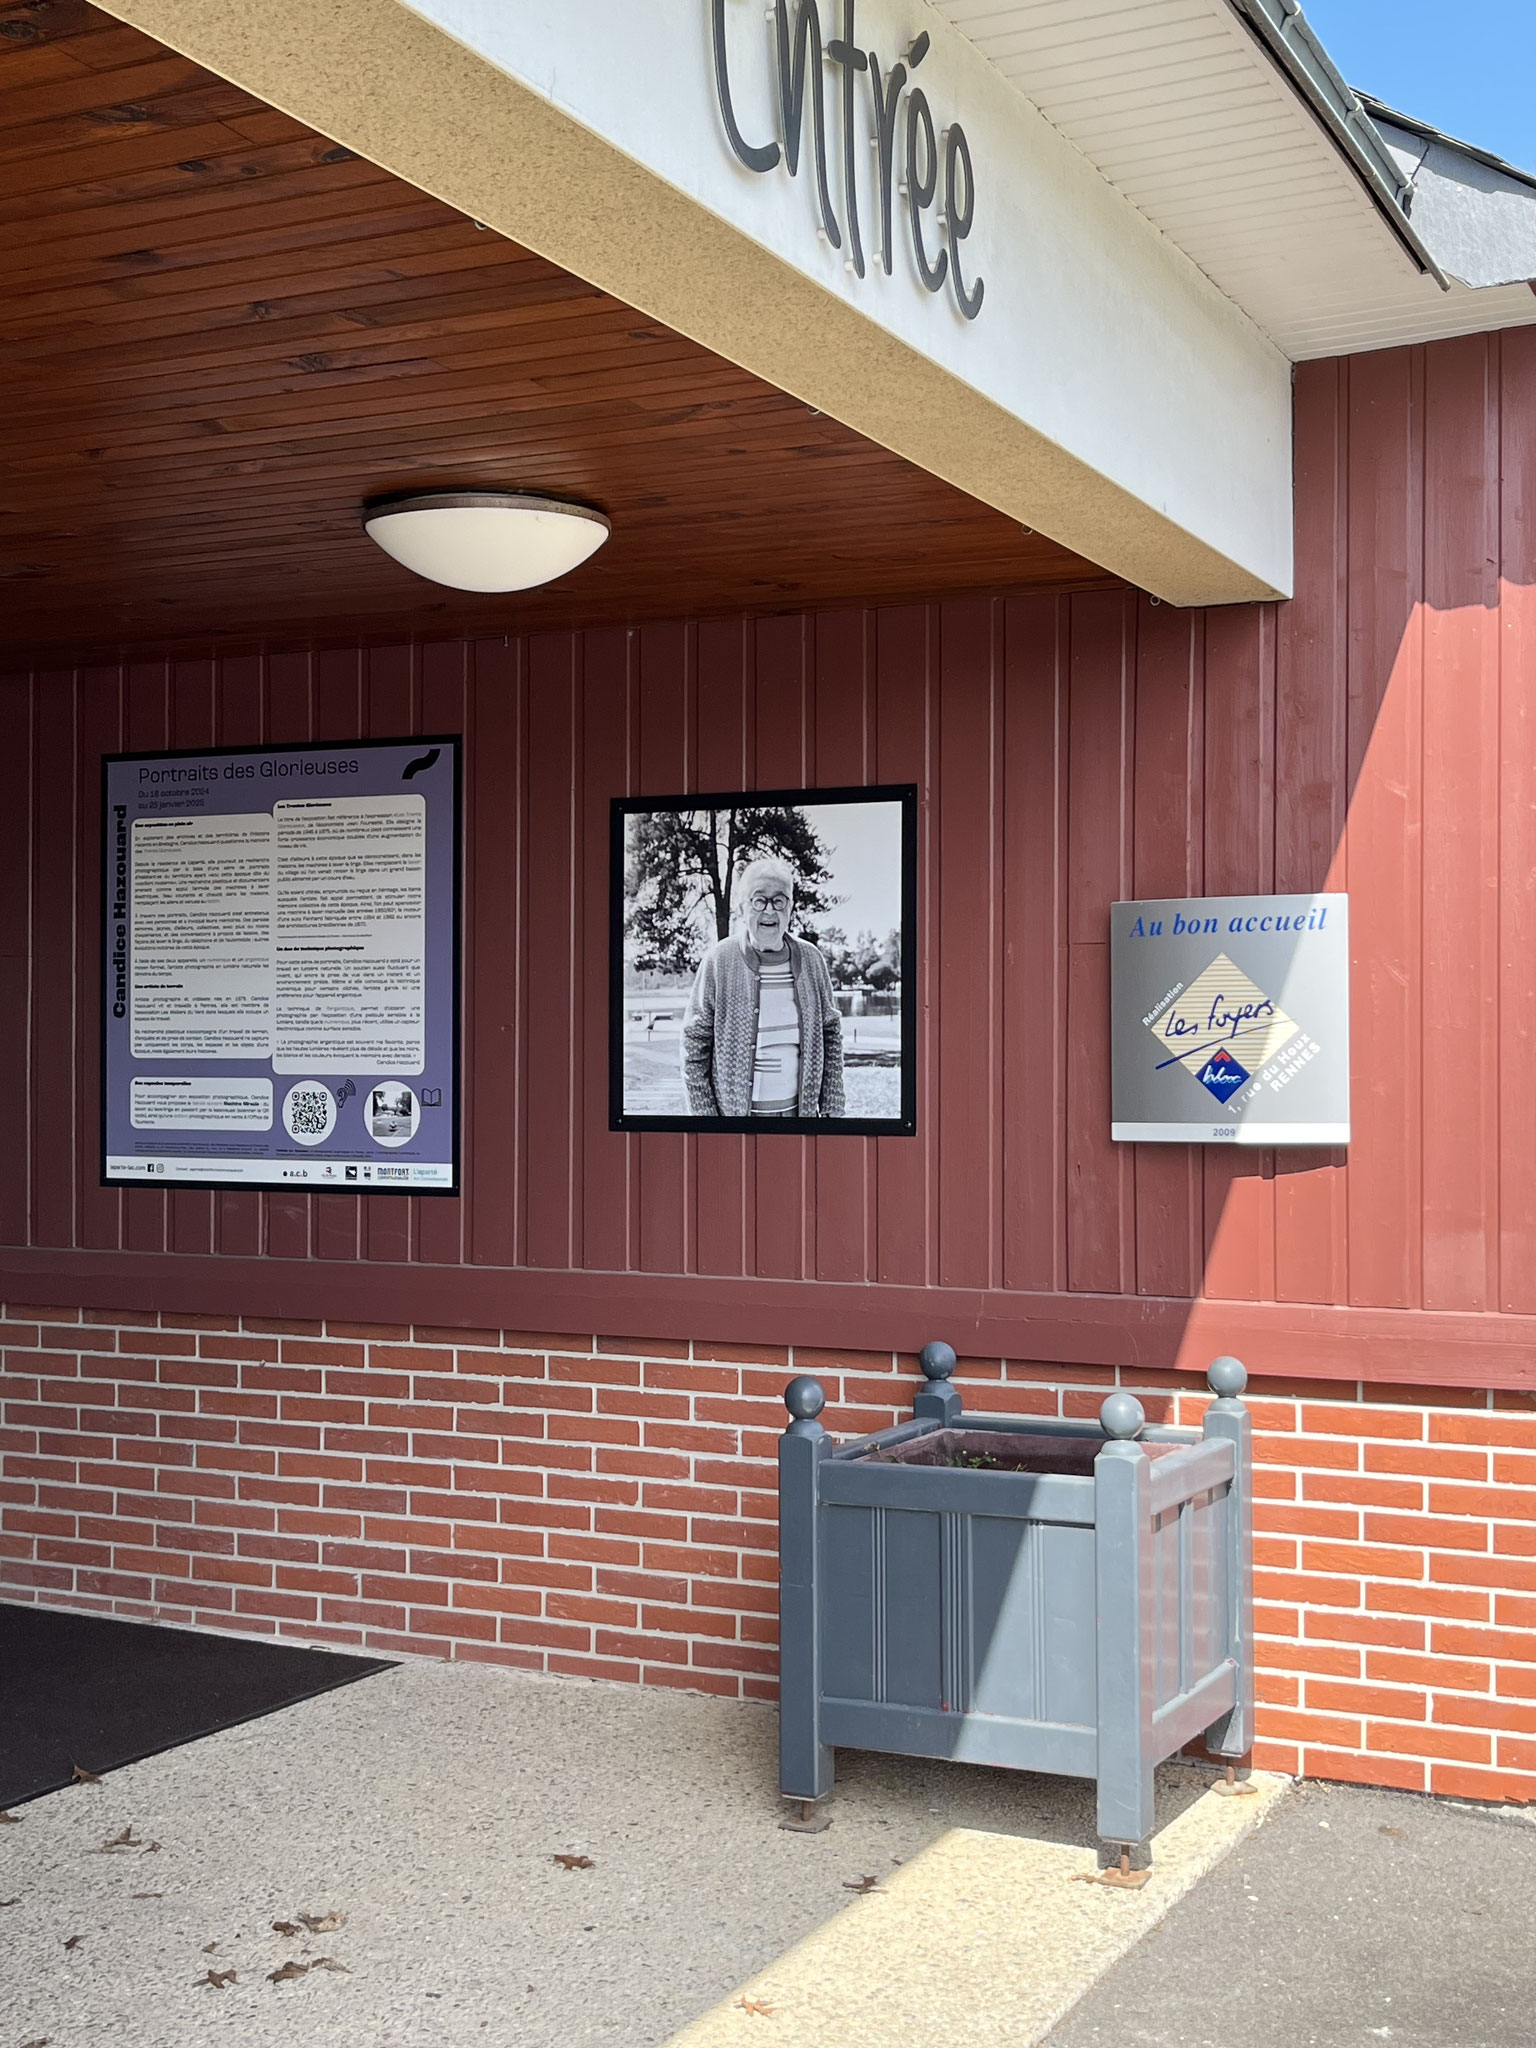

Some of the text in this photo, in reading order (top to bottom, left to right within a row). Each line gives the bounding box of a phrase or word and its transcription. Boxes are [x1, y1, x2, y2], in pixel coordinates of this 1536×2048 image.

[138, 759, 359, 784] Portraits des Glorieuses
[159, 800, 185, 810] janvier
[160, 788, 190, 797] octobre
[190, 787, 210, 796] 2024
[112, 804, 127, 1019] Candice Hazouard
[1129, 908, 1328, 938] Au bon accueil
[1142, 982, 1184, 1026] Réalisation
[1228, 1033, 1311, 1114] 1, rue du Houx
[1269, 1042, 1321, 1092] RENNES
[1212, 1128, 1236, 1137] 2009
[377, 1167, 410, 1176] MONTFORT
